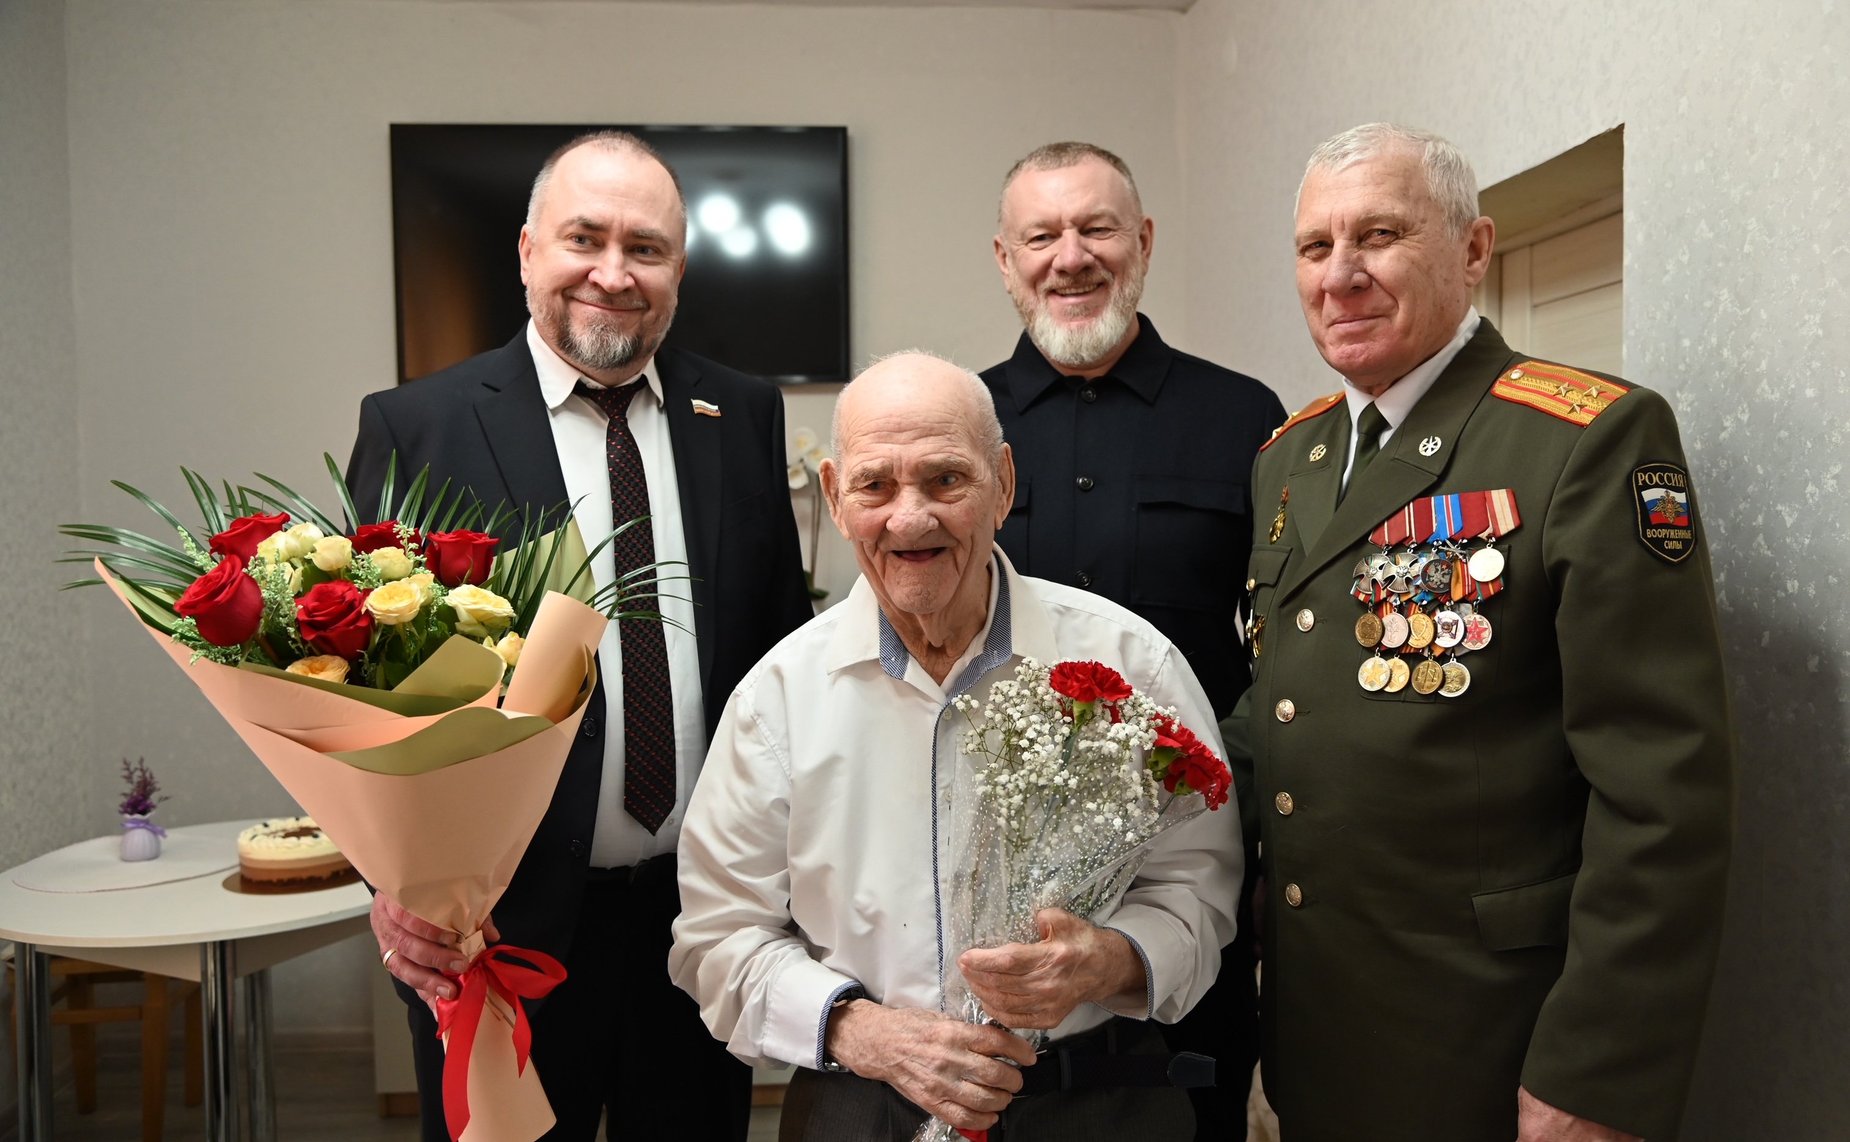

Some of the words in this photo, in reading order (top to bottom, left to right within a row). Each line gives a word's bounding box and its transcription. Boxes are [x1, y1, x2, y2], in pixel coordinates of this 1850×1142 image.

[1637, 472, 1685, 487] РОССИЯ
[1646, 529, 1692, 539] ВООРУЖЕННЫЕ
[1663, 540, 1683, 550] СИЛЫ
